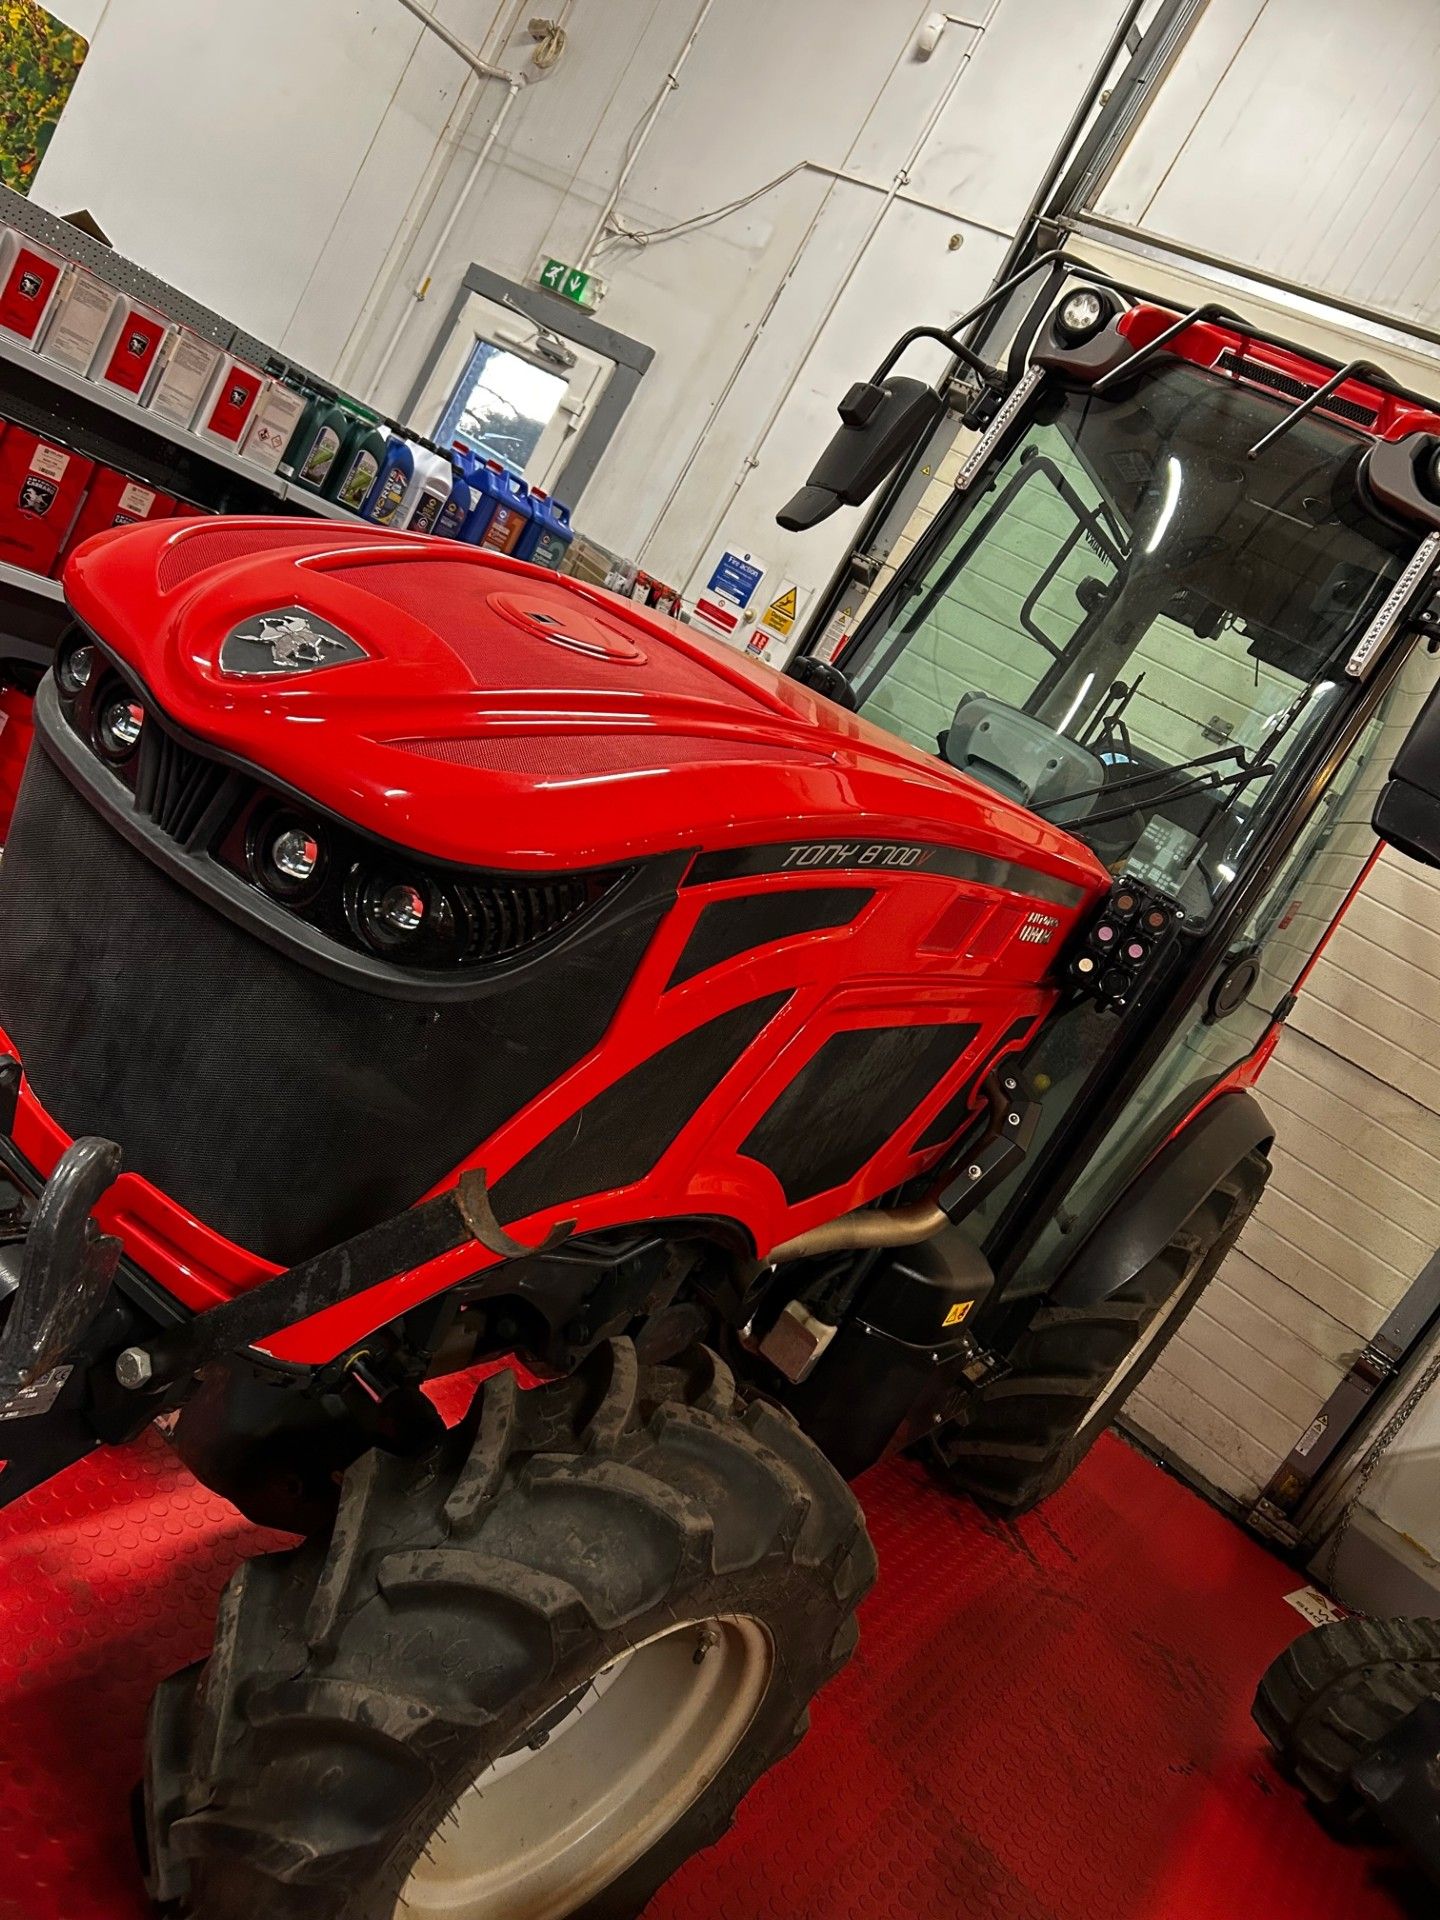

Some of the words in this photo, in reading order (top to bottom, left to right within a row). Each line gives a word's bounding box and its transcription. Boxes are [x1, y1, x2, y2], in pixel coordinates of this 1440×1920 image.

[372, 470, 397, 517] MORRIS
[727, 555, 741, 567] Fire
[738, 562, 759, 577] action
[781, 844, 860, 867] TONY
